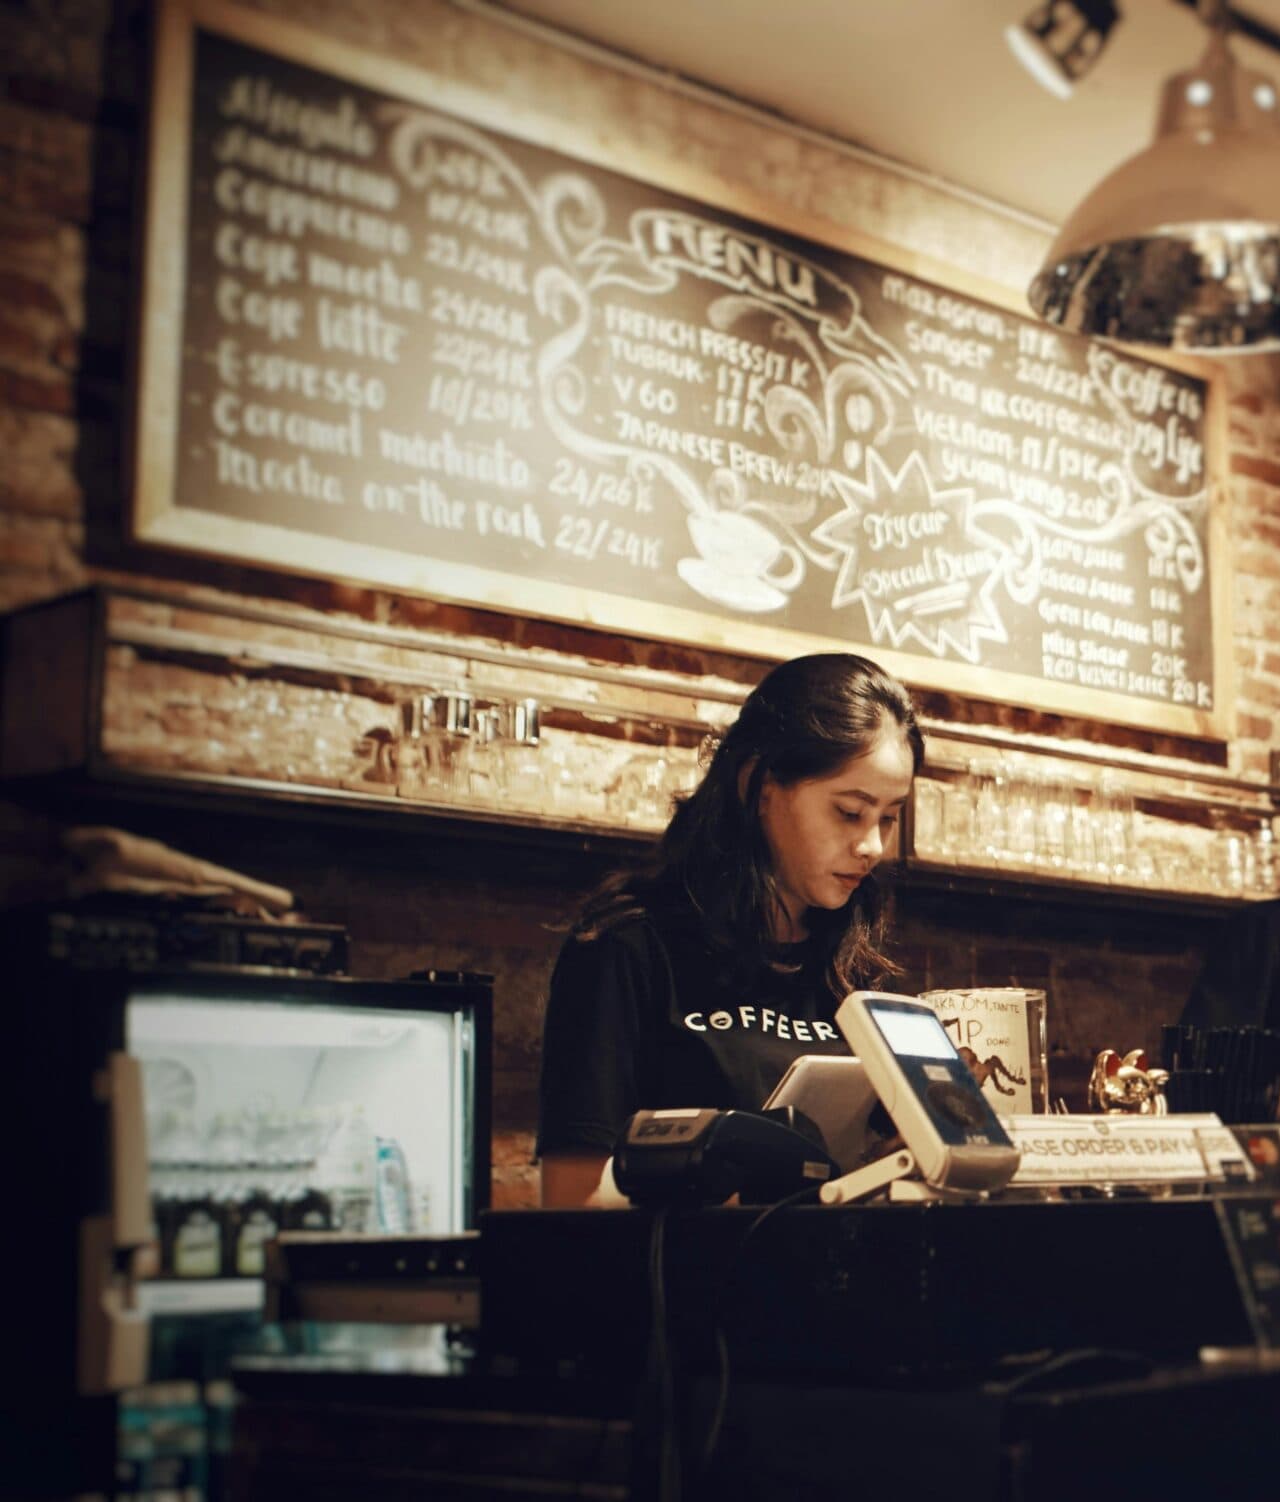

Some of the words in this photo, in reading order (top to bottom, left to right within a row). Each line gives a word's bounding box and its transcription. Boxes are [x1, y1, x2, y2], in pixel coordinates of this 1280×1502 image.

[653, 216, 819, 308] MENU
[214, 336, 388, 412] Espresso
[604, 302, 698, 351] FRENCH
[700, 327, 766, 375] PRESS
[611, 409, 725, 467] JAPANESE
[1020, 1138, 1062, 1156] ASE
[1061, 1138, 1127, 1156] ORDER
